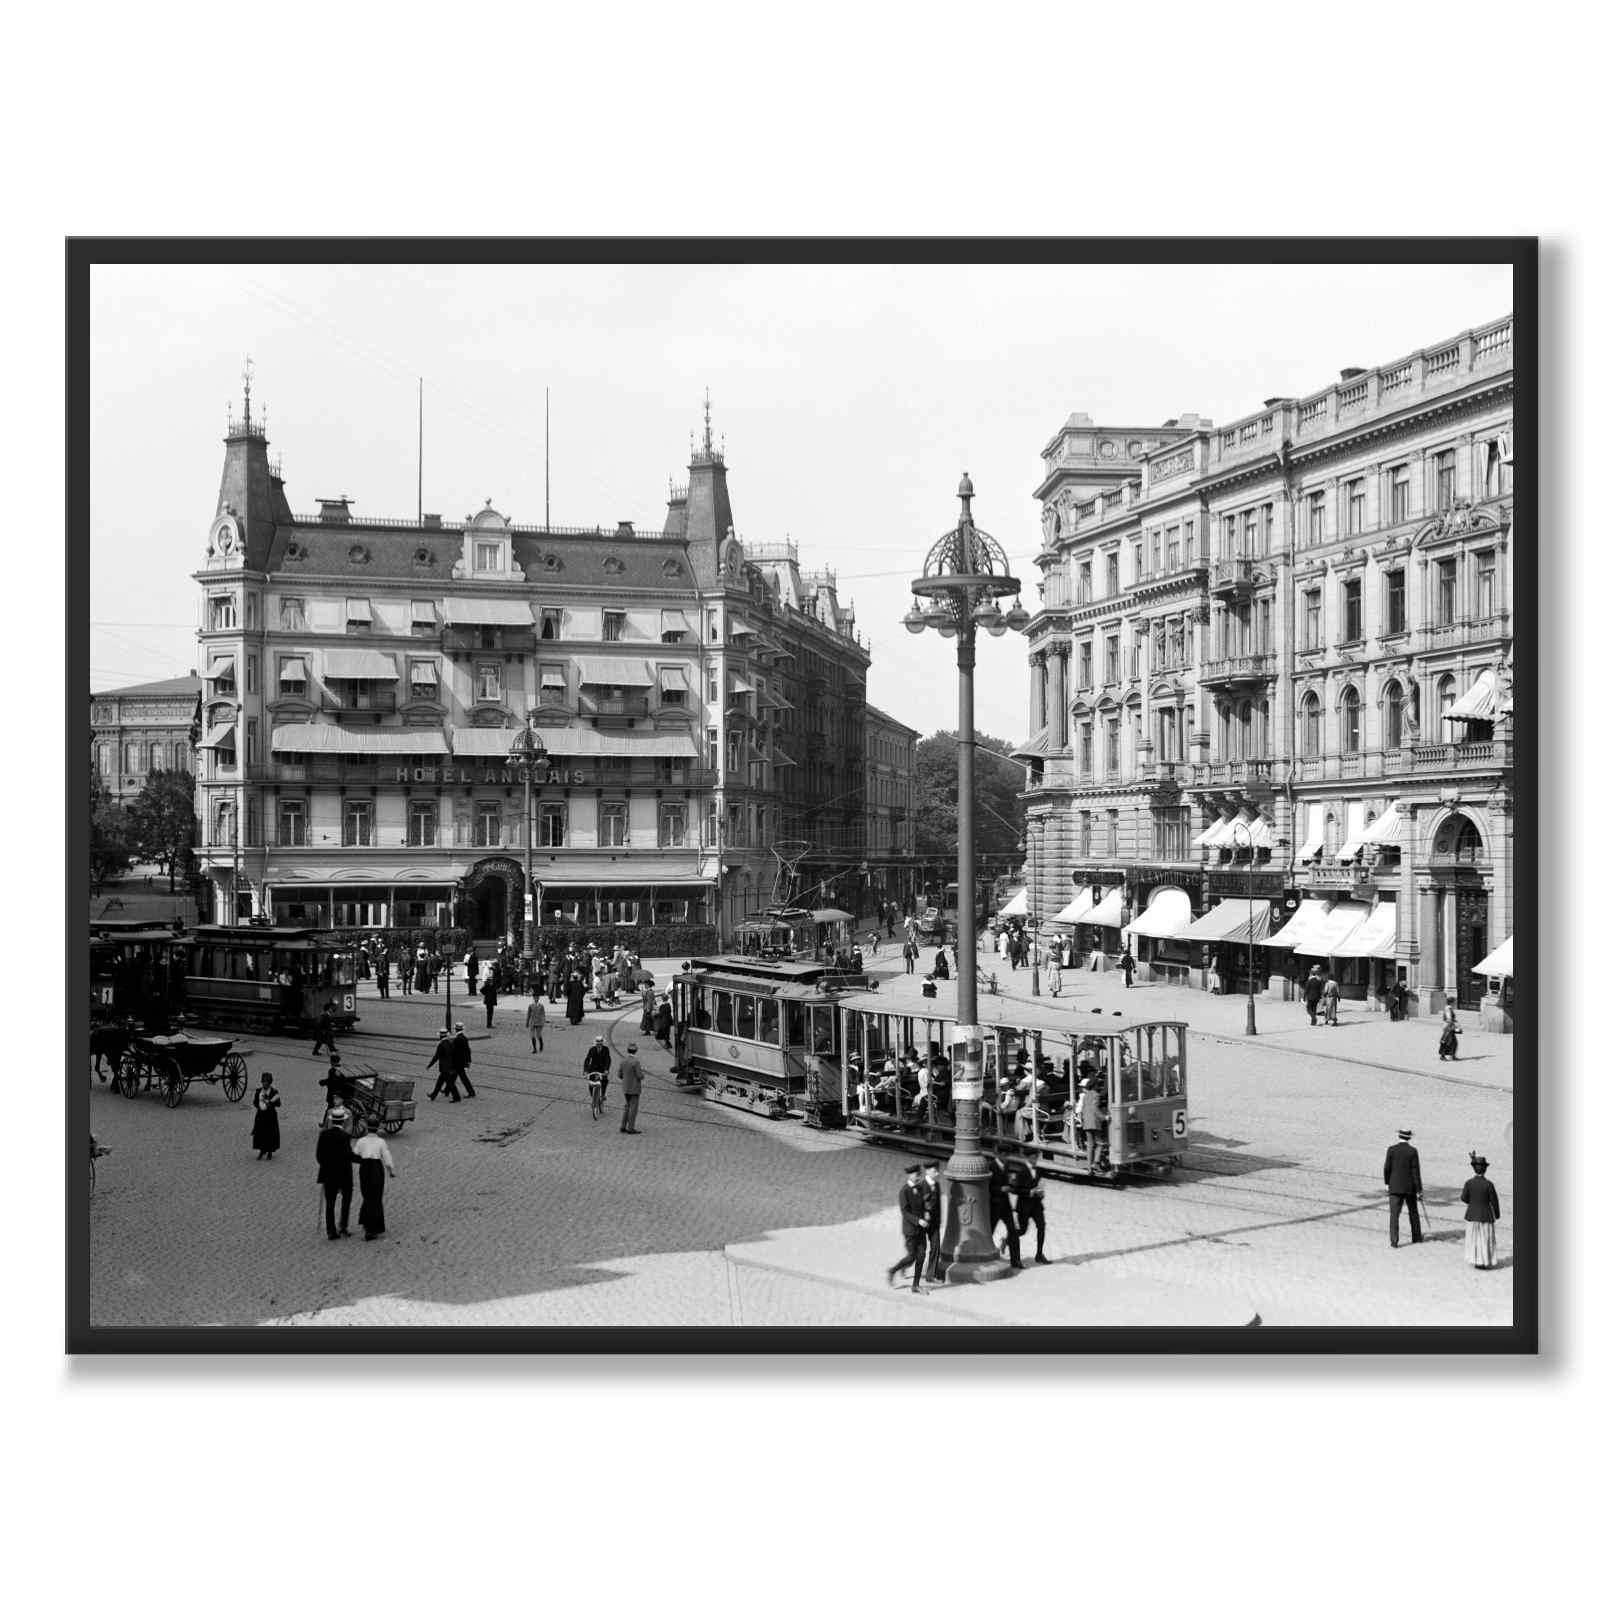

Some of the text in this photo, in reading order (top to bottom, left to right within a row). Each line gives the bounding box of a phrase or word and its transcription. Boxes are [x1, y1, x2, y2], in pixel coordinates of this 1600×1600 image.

[396, 767, 472, 783] HOTEL
[345, 996, 353, 1010] 3
[1175, 1111, 1185, 1135] 5
